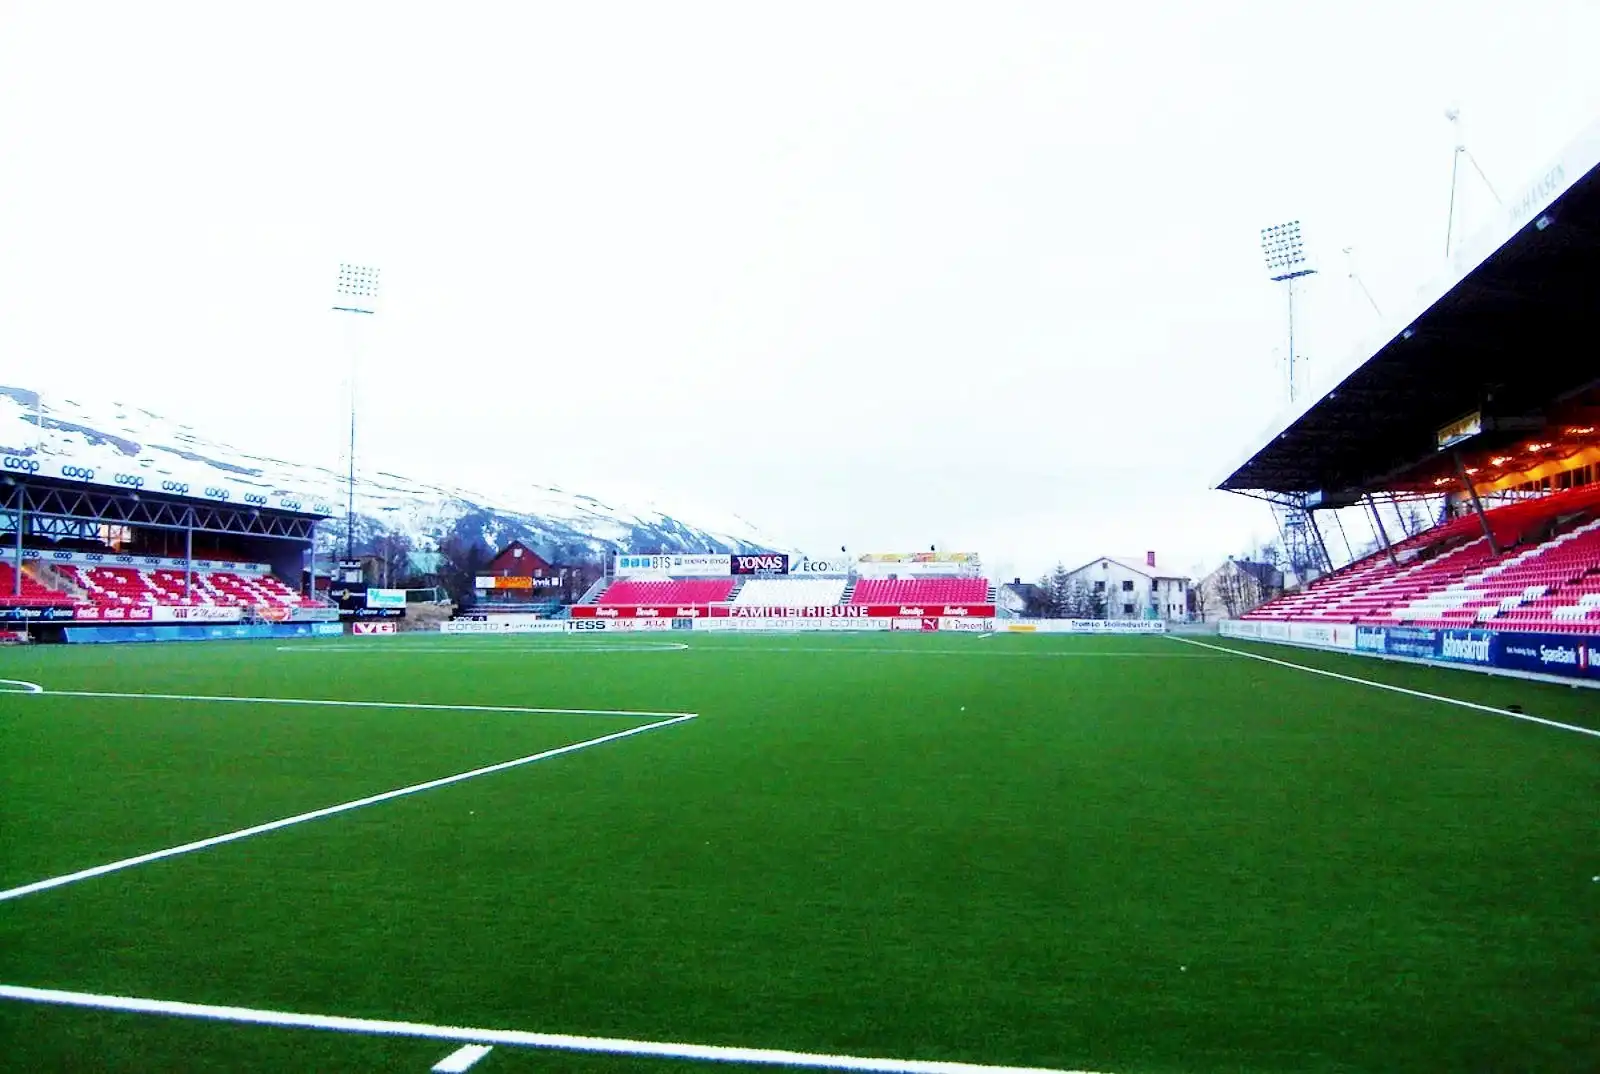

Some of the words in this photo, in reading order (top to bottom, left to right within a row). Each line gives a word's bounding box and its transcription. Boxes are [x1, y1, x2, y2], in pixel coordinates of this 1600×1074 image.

[4, 456, 40, 475] coop
[62, 465, 94, 483] coop
[114, 473, 144, 490] coop
[162, 480, 189, 495] coop
[205, 487, 230, 500] coop
[244, 492, 268, 506] coop
[652, 556, 671, 569] BTS
[736, 556, 783, 569] YONAS
[729, 606, 869, 617] FAMILIETRIBUNE
[355, 622, 396, 635] VG
[567, 620, 606, 630] TESS
[1540, 644, 1577, 665] SpareBank
